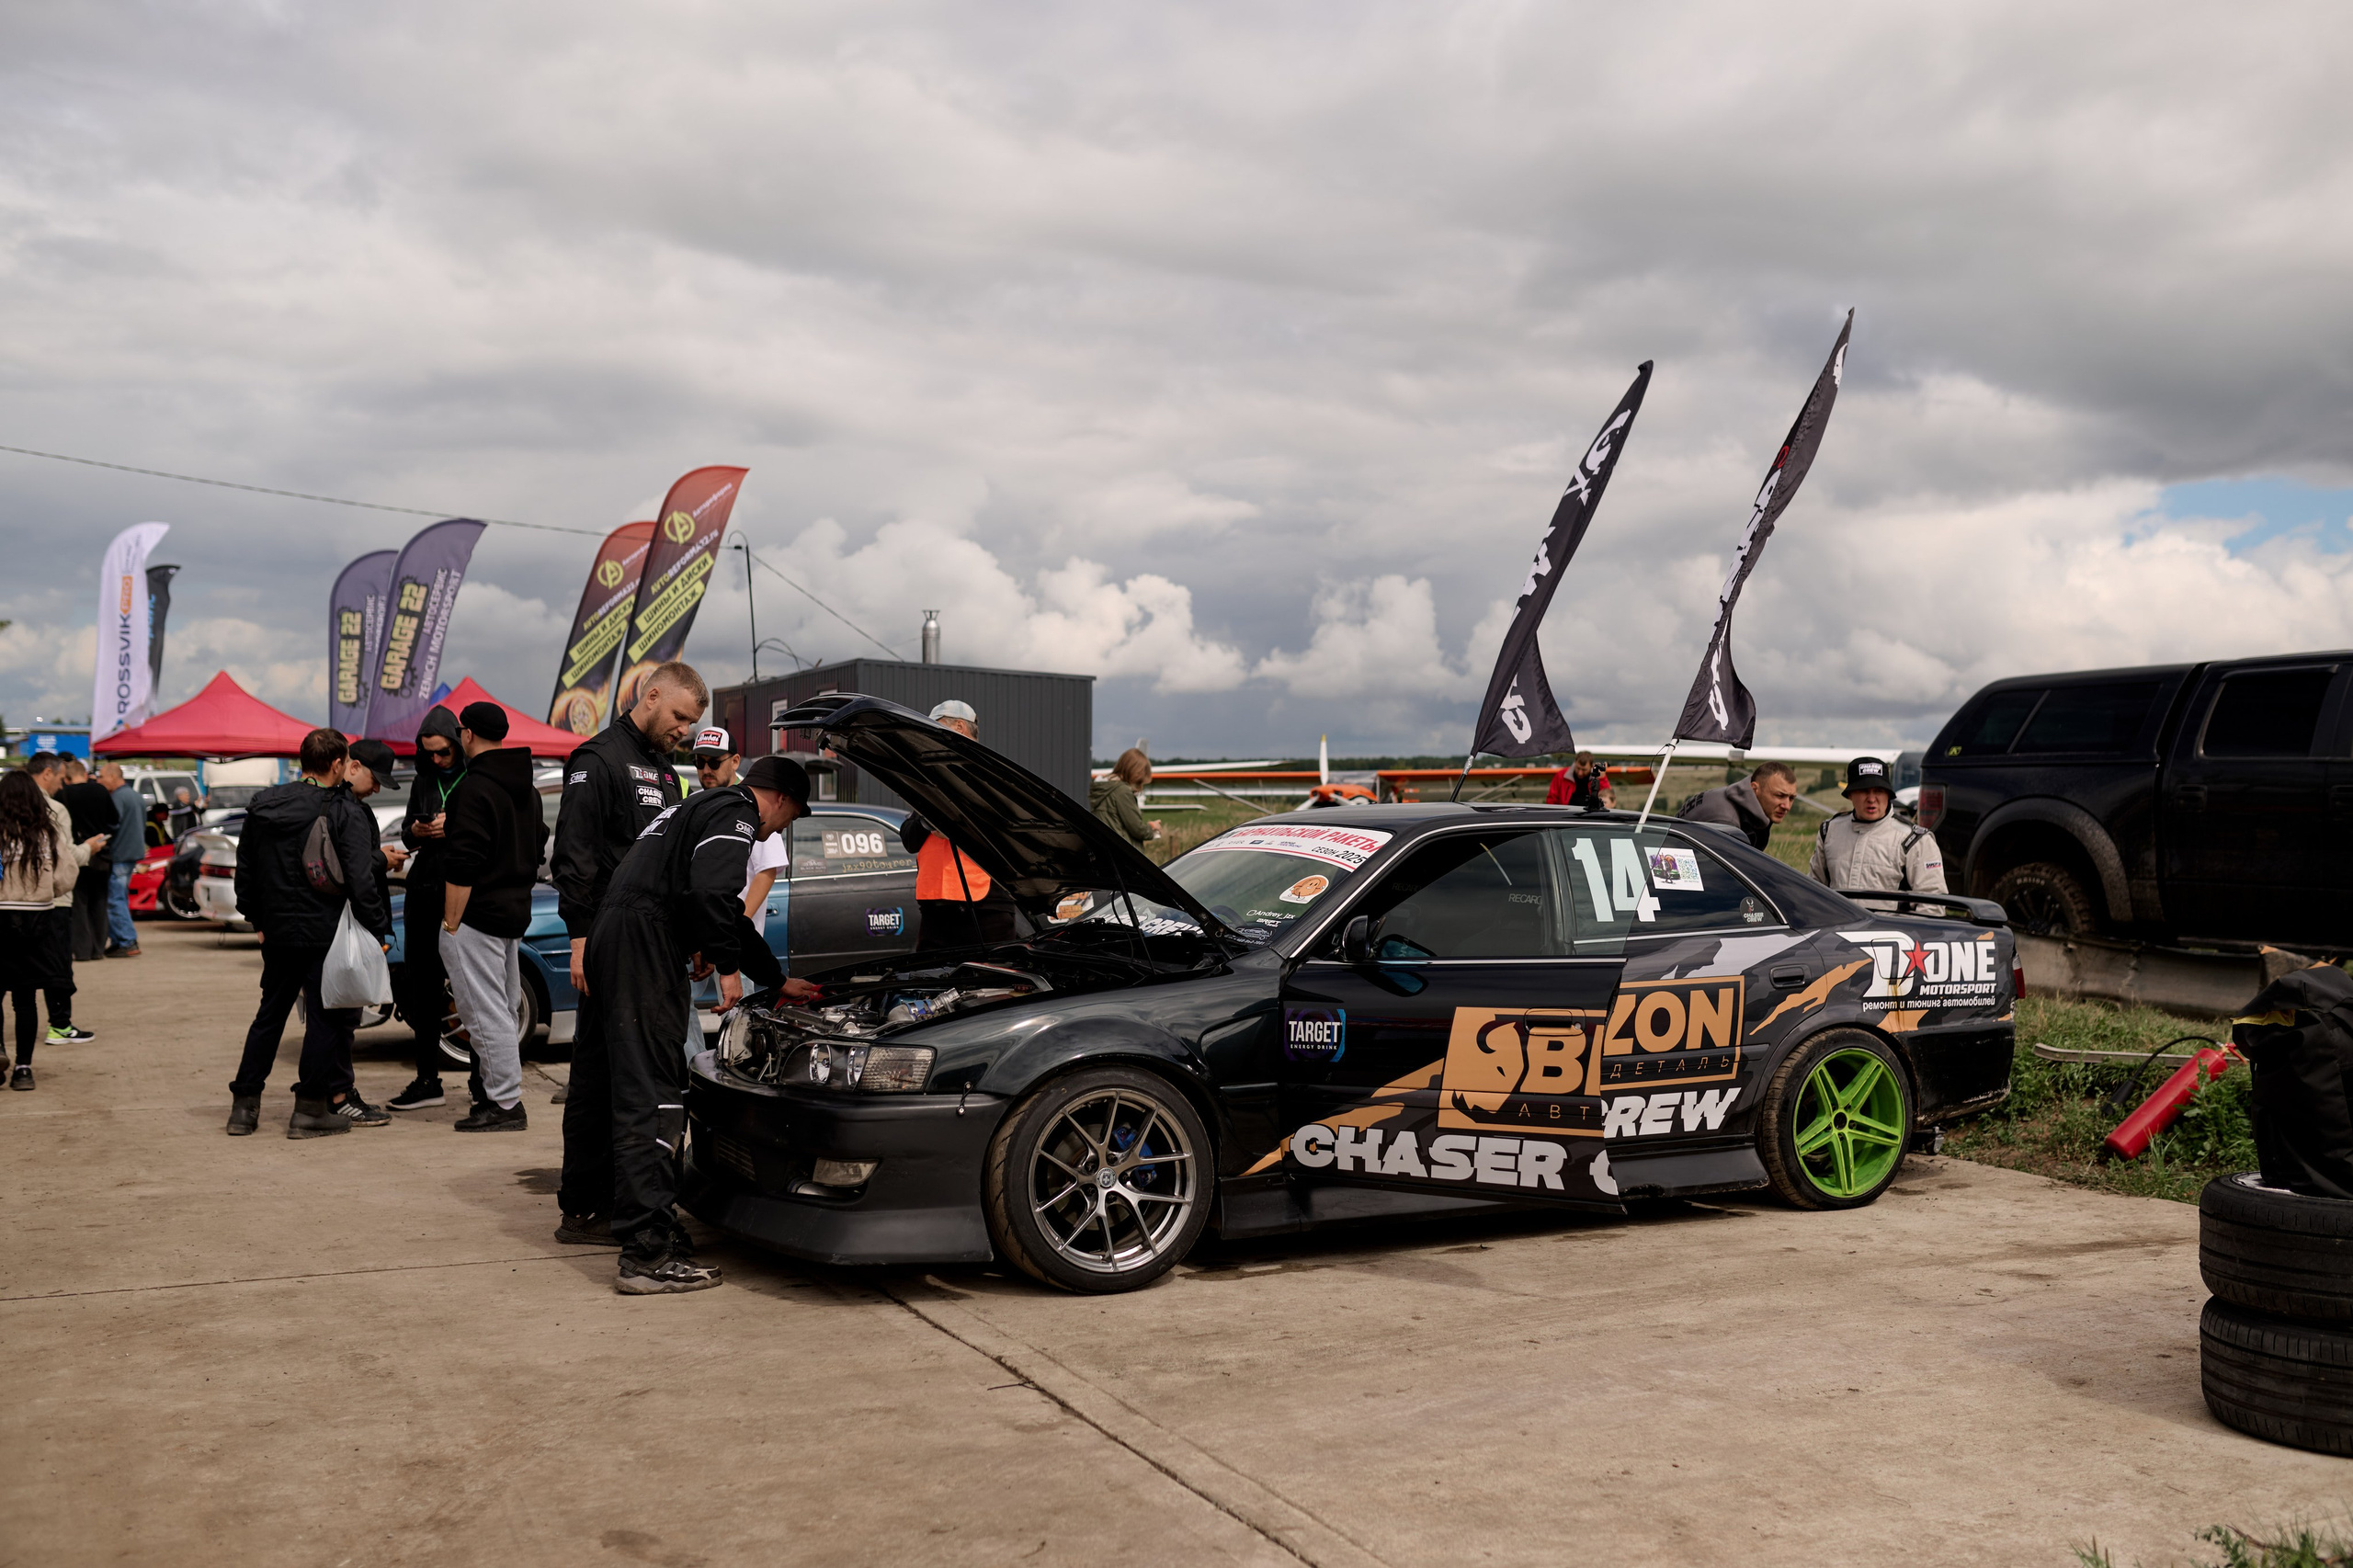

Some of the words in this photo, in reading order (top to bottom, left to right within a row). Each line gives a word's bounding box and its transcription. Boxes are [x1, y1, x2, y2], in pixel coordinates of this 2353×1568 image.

[399, 582, 428, 613] 22
[643, 592, 672, 624] ШИНЫ
[680, 557, 710, 589] ДИСКИ
[340, 611, 362, 636] 22
[430, 567, 462, 653] MOTORSPORT
[637, 589, 699, 653] ШИНОМОНТАЖ
[380, 614, 419, 690] GARAGE
[571, 627, 626, 680] ШИНОМОНТАЖ
[576, 628, 601, 655] ШИНЫ
[117, 613, 131, 715] ROSSVIK
[337, 639, 360, 703] GARAGE
[570, 773, 587, 782] OMP
[841, 833, 882, 855] 096
[1311, 846, 1340, 856] СЕЗОН
[1335, 849, 1368, 864] 2025
[1571, 837, 1661, 922] 14
[868, 914, 901, 926] TARGET
[1743, 911, 1765, 920] CHASER
[1862, 1000, 1898, 1012] ремонт
[1900, 1000, 1905, 1008] и
[1907, 998, 1941, 1009] тюнинг
[1942, 995, 1996, 1007] автомобилей
[1919, 983, 1997, 997] MOTORSPORT
[1289, 1020, 1341, 1043] TARGET
[1290, 1124, 1568, 1191] CHASER
